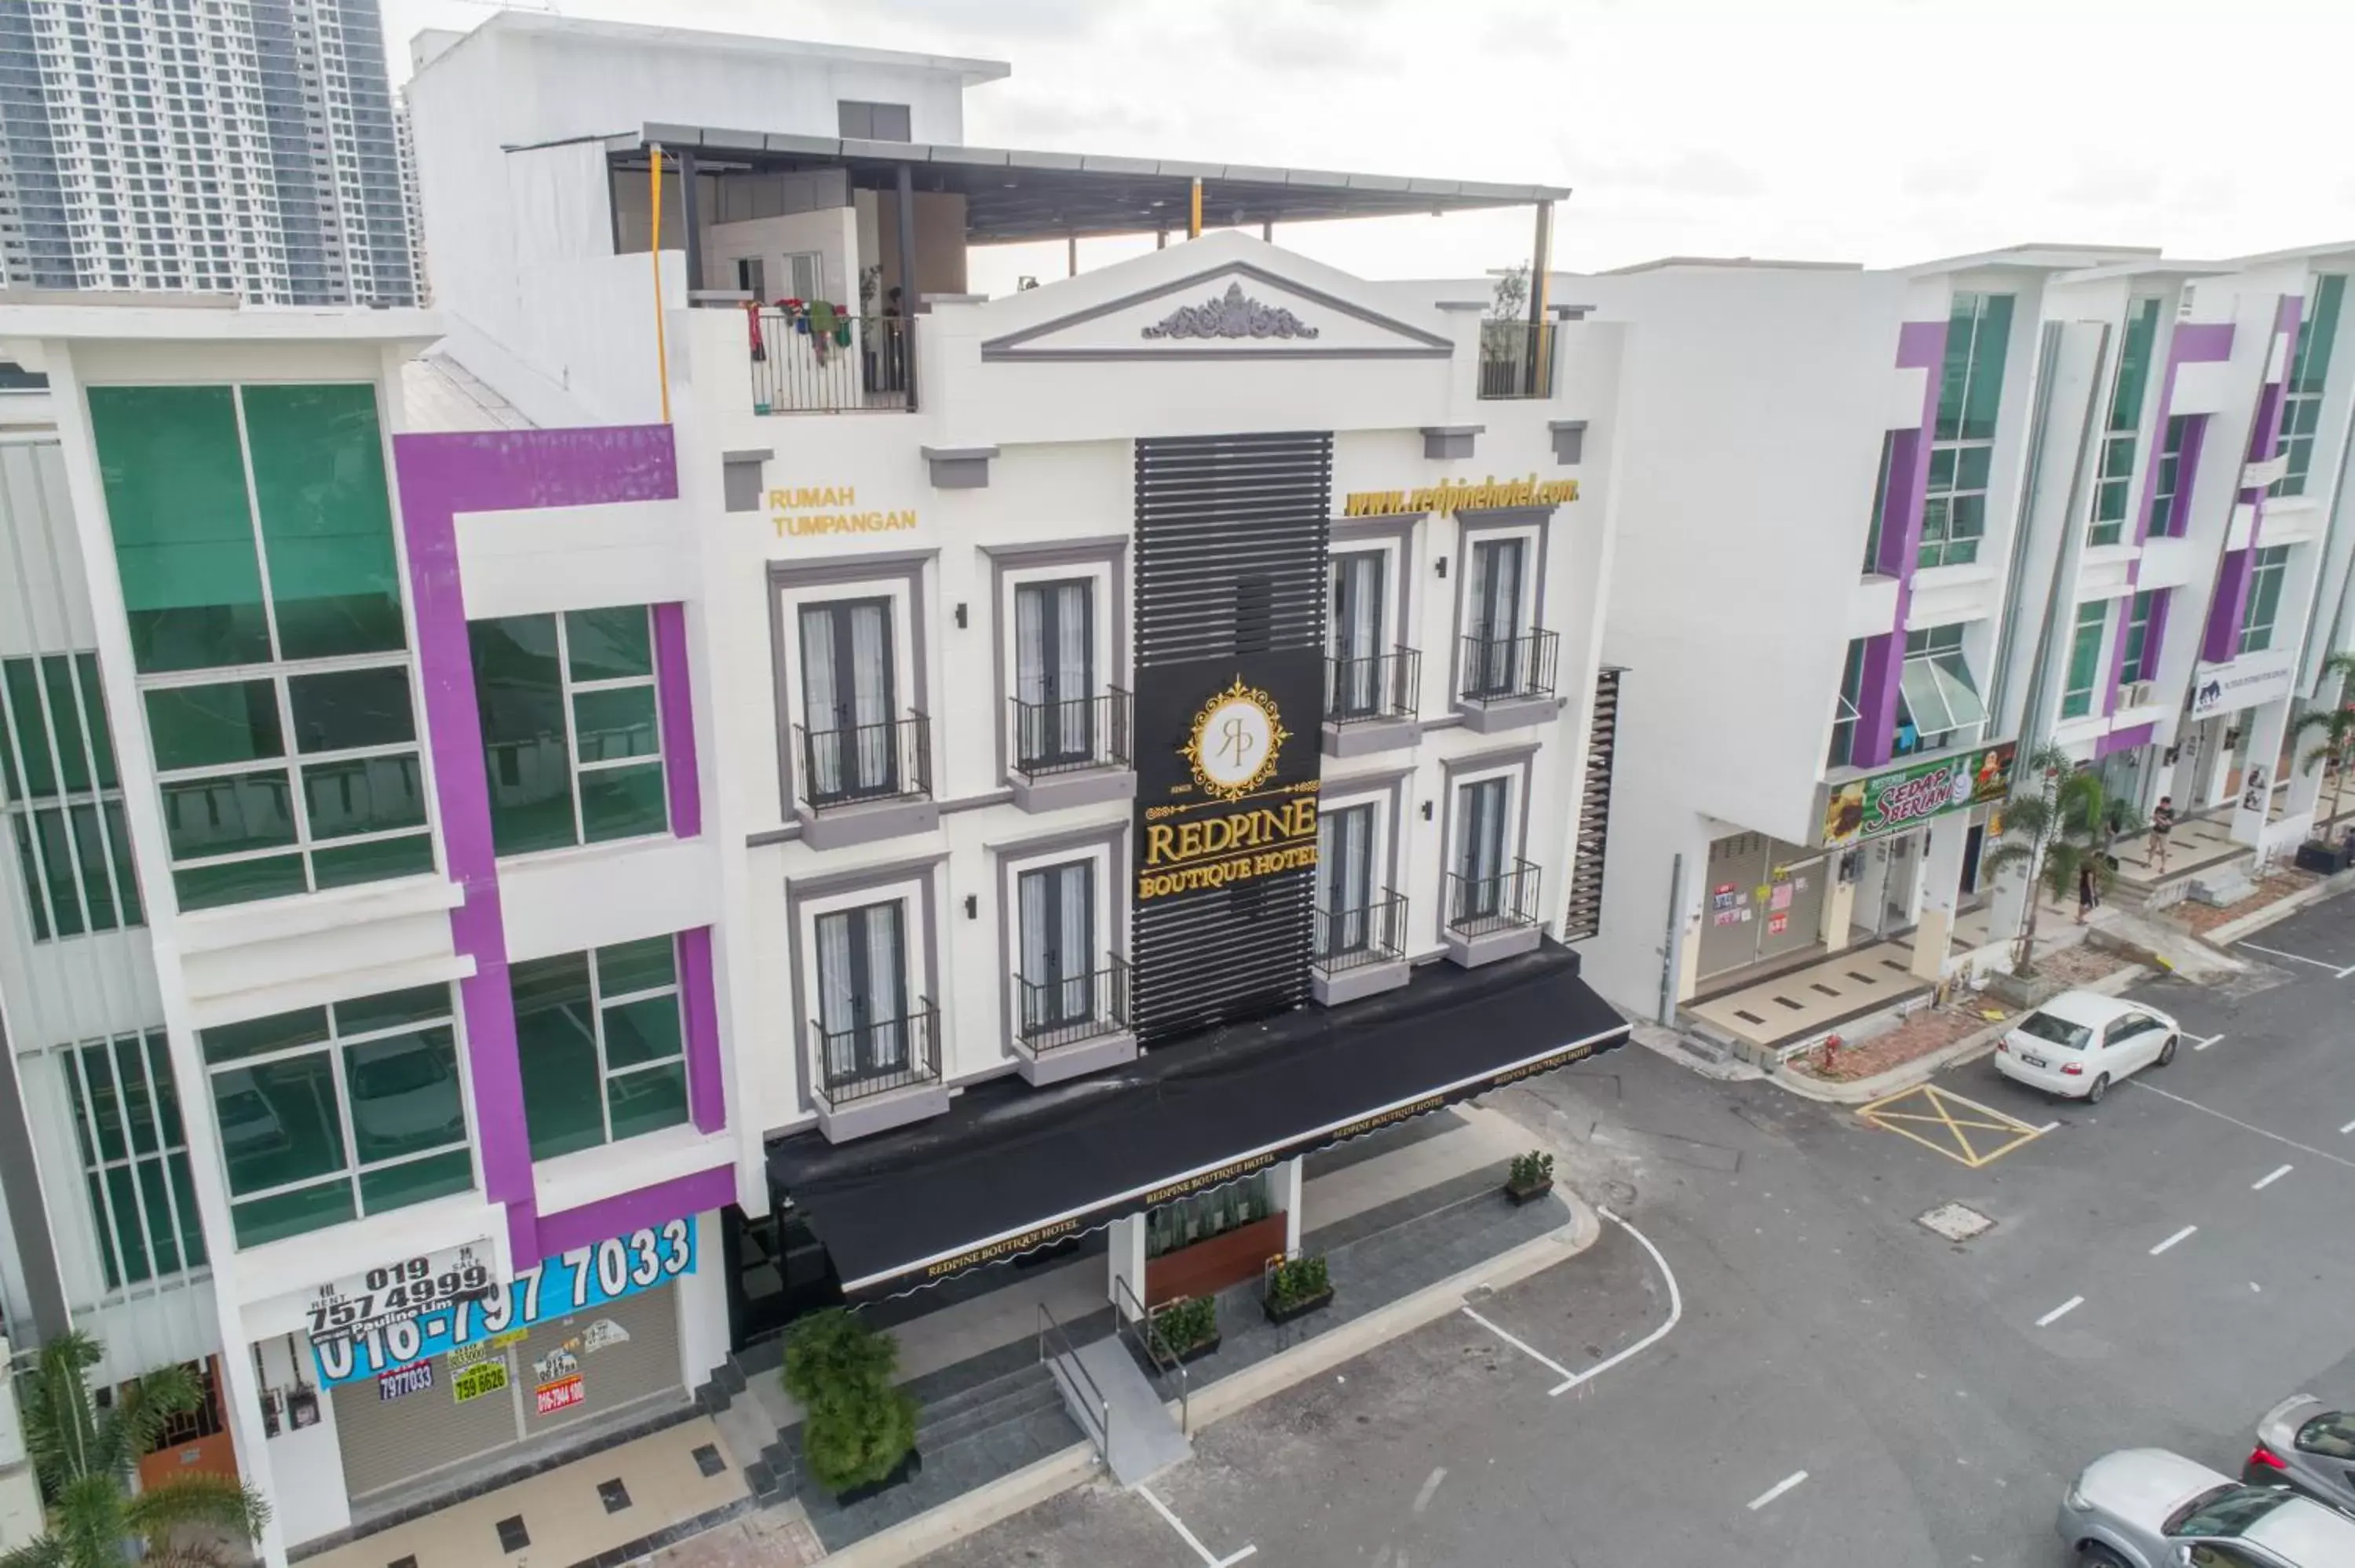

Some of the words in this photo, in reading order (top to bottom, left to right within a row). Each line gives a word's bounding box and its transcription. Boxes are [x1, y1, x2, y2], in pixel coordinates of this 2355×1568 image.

[769, 487, 855, 510] RUMAH
[1344, 472, 1579, 519] www.redpinehotel.com
[772, 510, 917, 538] TUMPANGAN
[1865, 768, 1948, 833] SEDAP
[1889, 786, 1953, 822] BERIANI
[1146, 797, 1318, 864] REDPINE
[1139, 857, 1251, 899] BOUTIQUE
[1254, 845, 1319, 875] HOTEL
[1146, 1180, 1190, 1205] REDPINE
[1192, 1165, 1242, 1189] BOUTIQUE
[1244, 1154, 1275, 1171] HOTEL
[561, 1218, 690, 1307] 7033
[929, 1251, 981, 1277] REDPINE
[982, 1230, 1040, 1260] BOUTIQUE
[1042, 1217, 1080, 1239] HOTEL
[366, 1256, 430, 1291] 019
[306, 1295, 374, 1332] 757
[385, 1265, 487, 1308] 4999
[311, 1294, 345, 1310] RENT
[352, 1305, 418, 1335] Pauline
[421, 1298, 452, 1314] Lim
[381, 1365, 433, 1400] 7977033
[455, 1378, 477, 1401] 759
